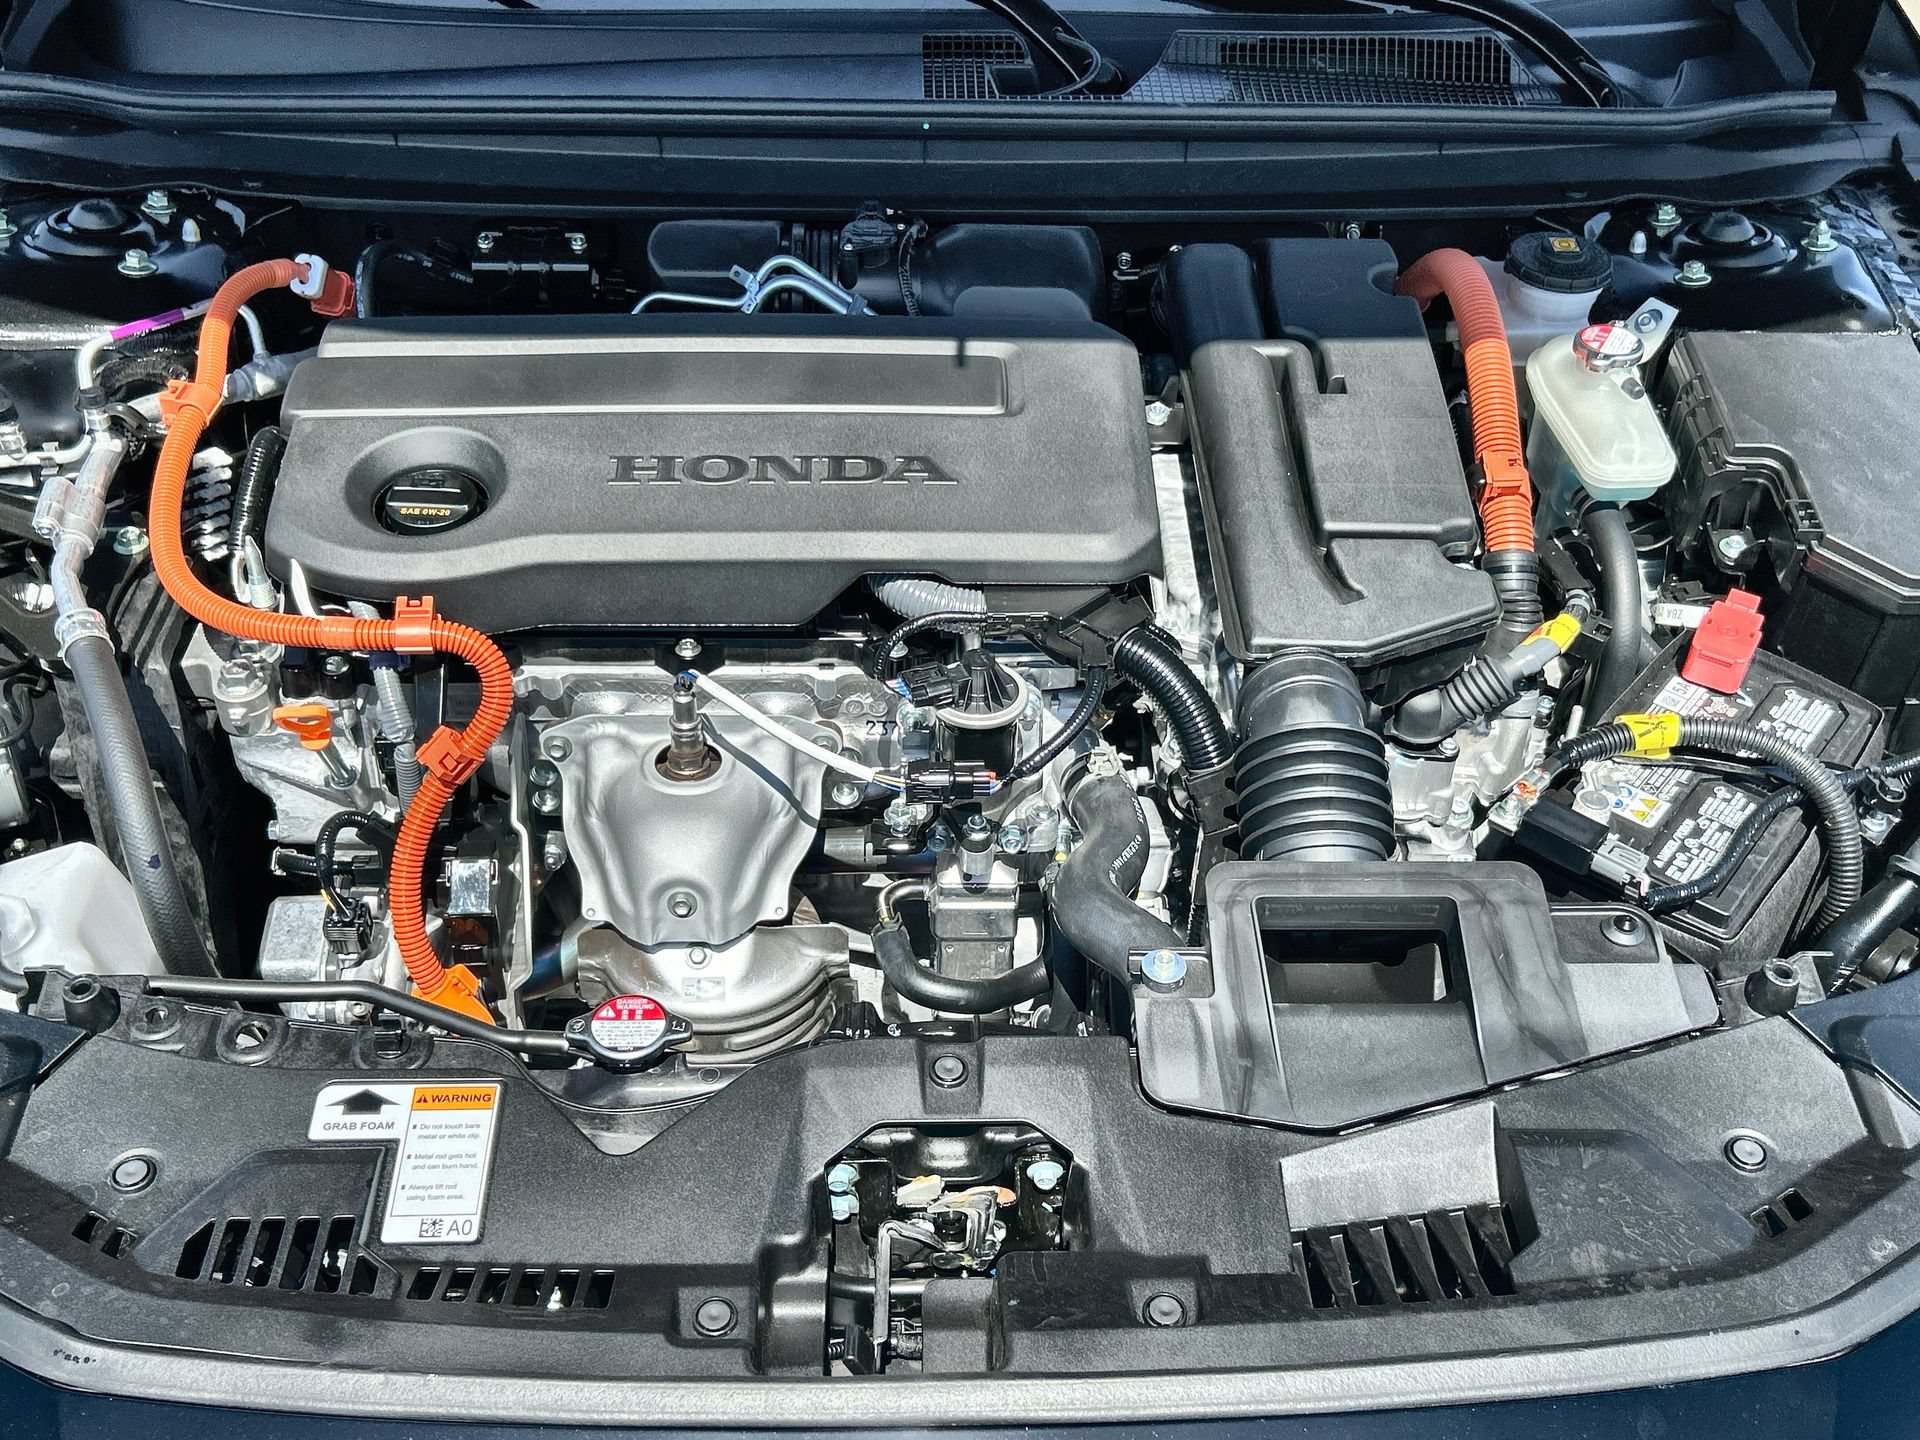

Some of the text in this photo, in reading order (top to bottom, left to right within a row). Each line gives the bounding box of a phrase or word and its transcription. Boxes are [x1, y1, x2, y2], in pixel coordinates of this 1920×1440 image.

[607, 454, 958, 486] HONDA
[400, 507, 421, 515] SAE
[431, 1094, 492, 1103] WARNING
[323, 1122, 395, 1131] GRAB FOAM
[446, 1219, 473, 1235] A0
